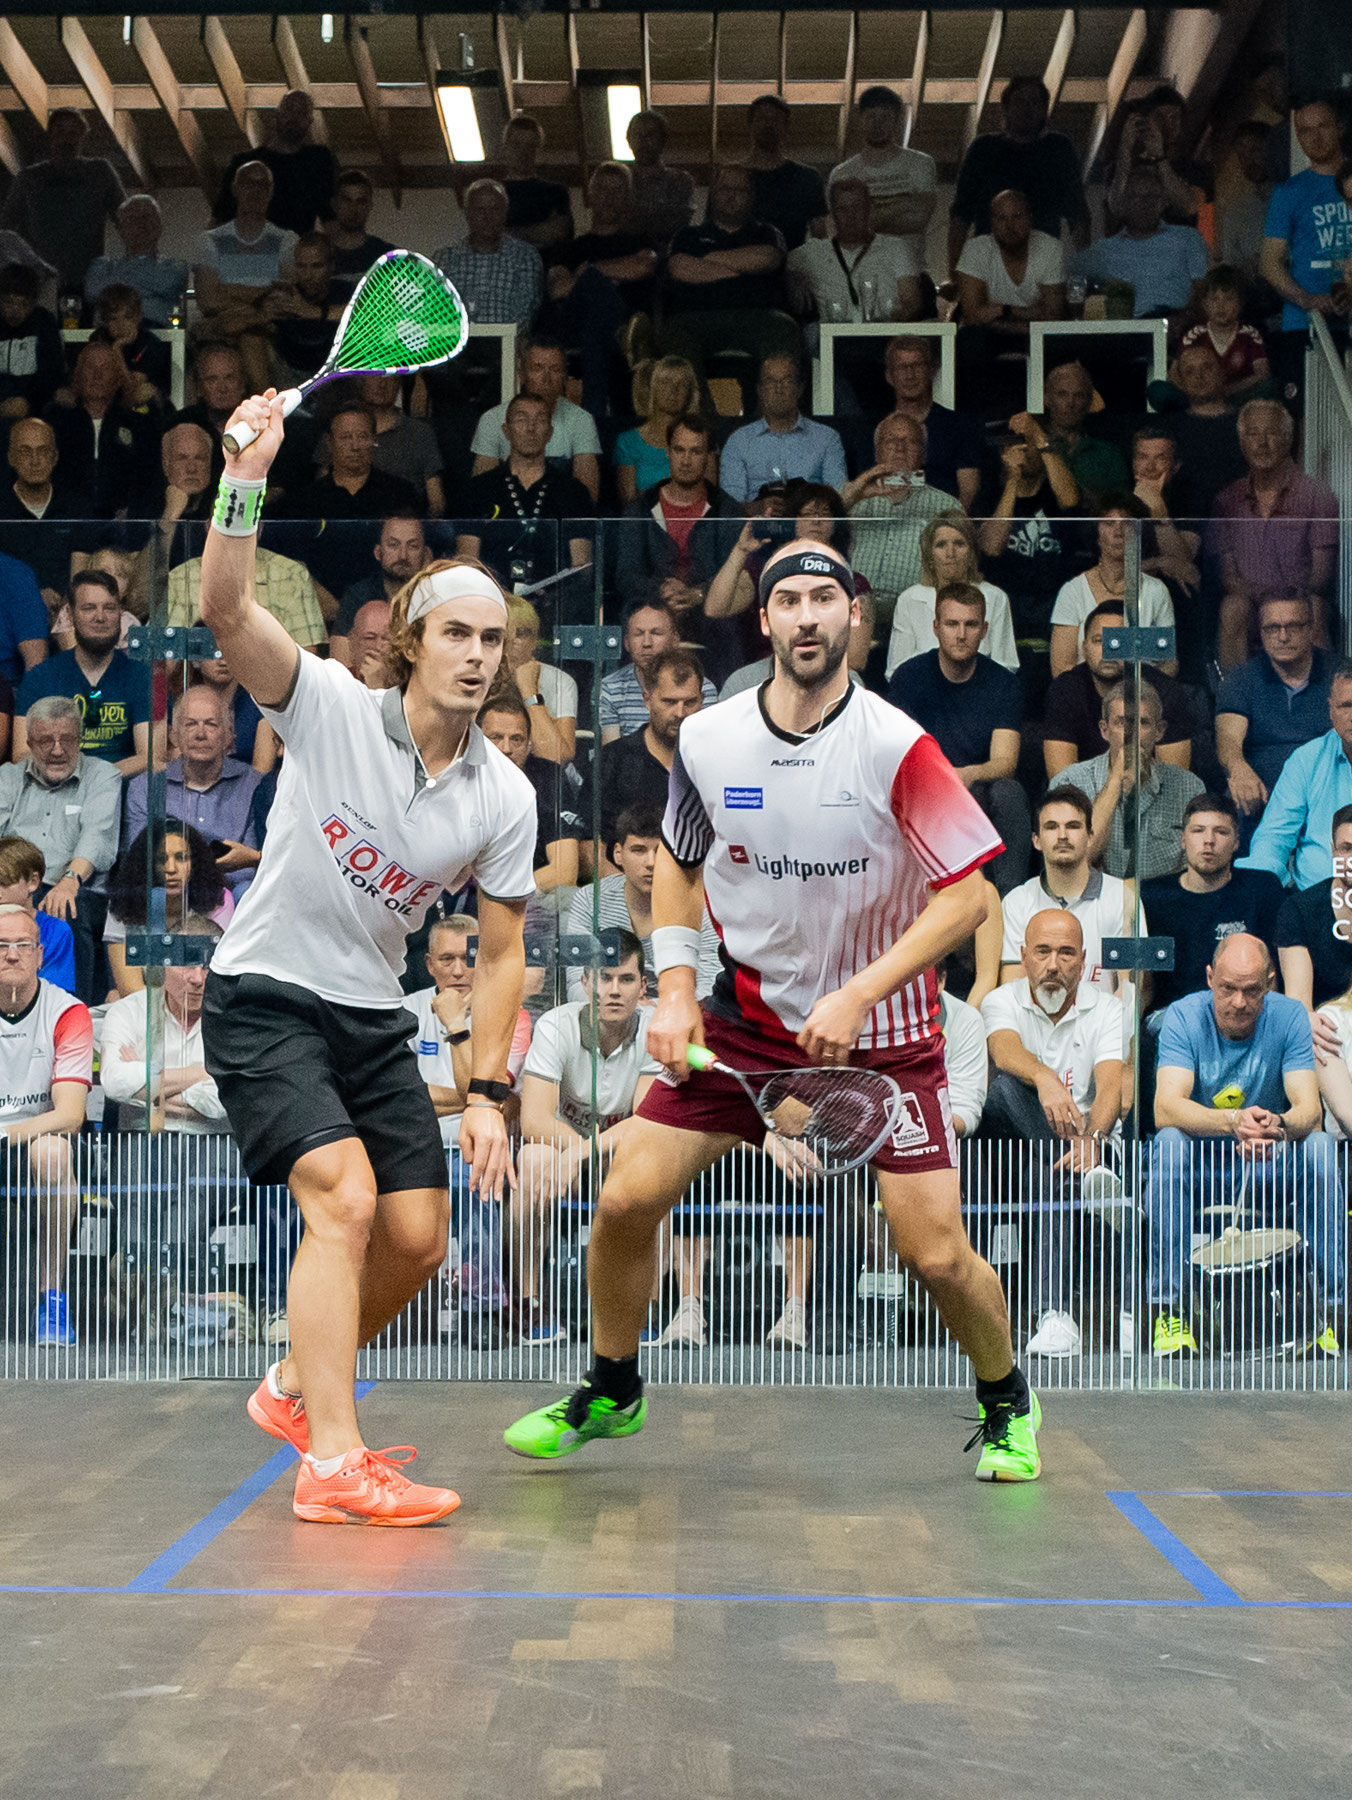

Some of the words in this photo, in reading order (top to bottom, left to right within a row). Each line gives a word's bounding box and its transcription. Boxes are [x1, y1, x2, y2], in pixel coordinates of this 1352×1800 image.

[1312, 202, 1352, 226] SPO
[323, 819, 436, 906] ROWE
[754, 853, 870, 882] Lightpower
[335, 856, 380, 898] TOR
[384, 897, 413, 916] OIL
